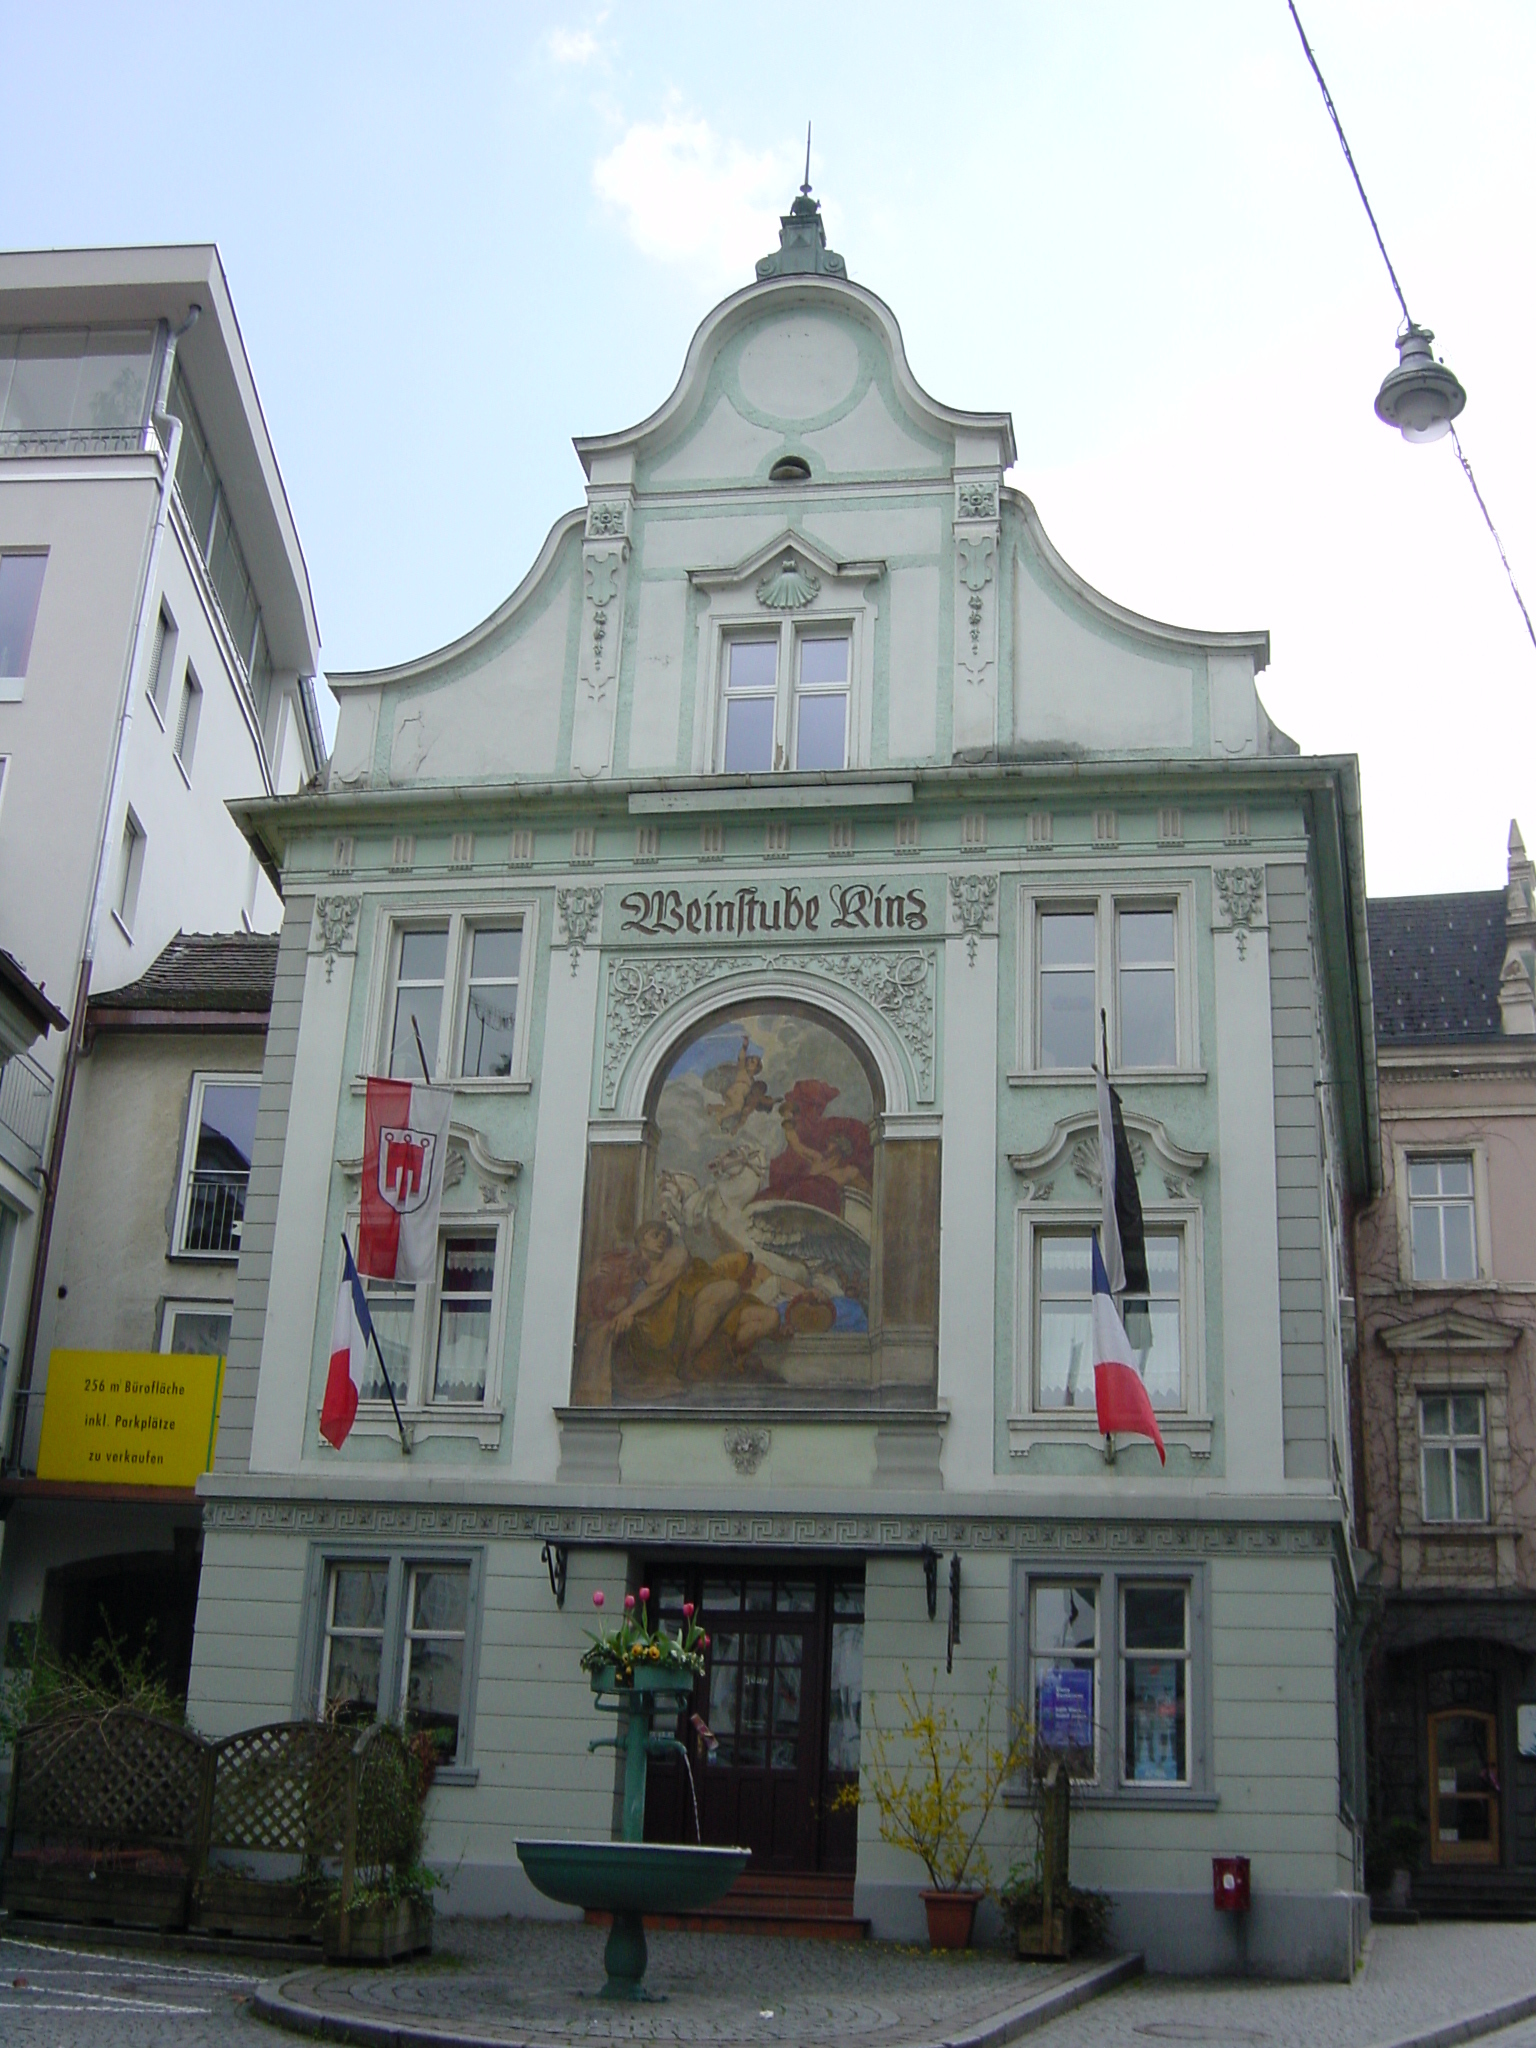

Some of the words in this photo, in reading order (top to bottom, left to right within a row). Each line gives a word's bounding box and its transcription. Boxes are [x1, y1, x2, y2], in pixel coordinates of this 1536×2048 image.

[829, 883, 929, 931] Kinz
[84, 1378, 105, 1392] 256
[124, 1380, 185, 1396] Bürofläche
[84, 1413, 110, 1427] inkl.
[115, 1414, 176, 1431] Parkplätze
[88, 1451, 101, 1462] zu
[106, 1449, 164, 1464] verkaufen
